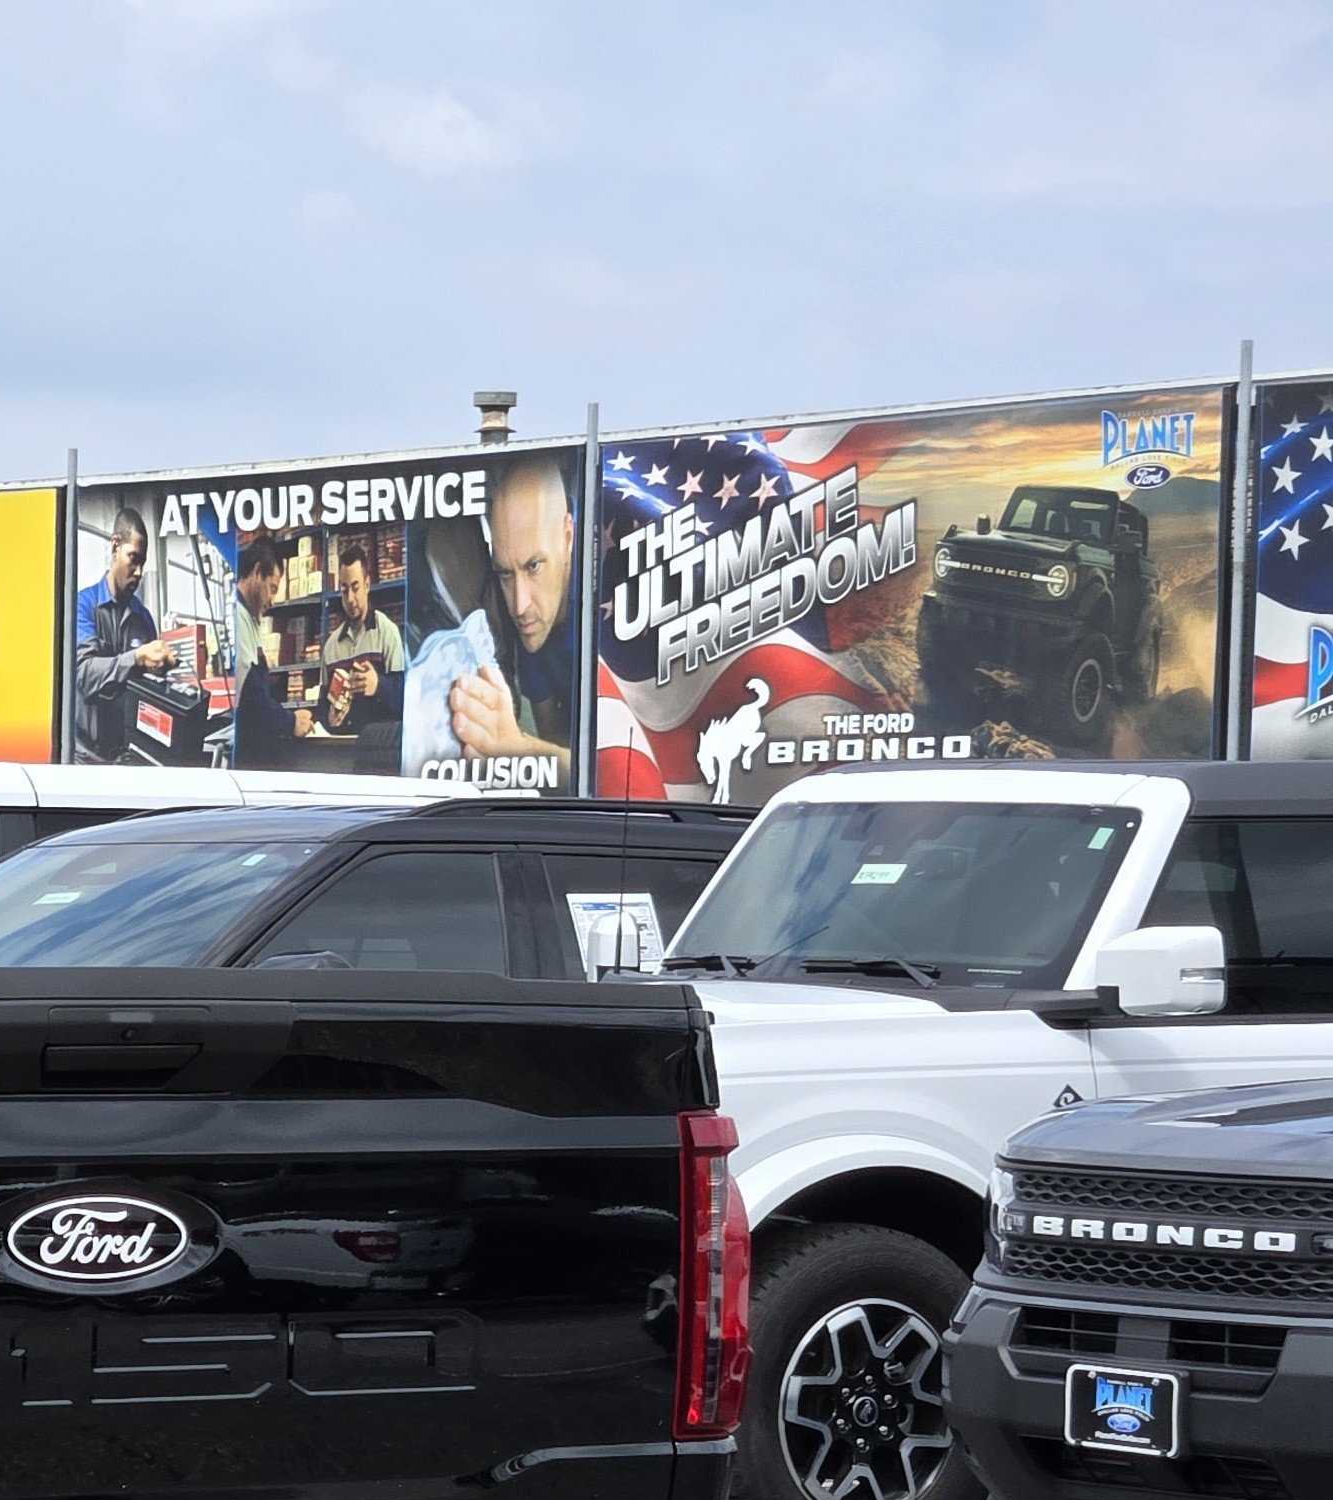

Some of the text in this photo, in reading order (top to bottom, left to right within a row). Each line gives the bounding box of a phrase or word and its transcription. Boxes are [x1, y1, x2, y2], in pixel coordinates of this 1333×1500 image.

[1101, 410, 1197, 466] PLANET
[160, 470, 487, 537] AT YOUR SERVICE
[1134, 467, 1164, 486] Ford
[614, 467, 858, 642] ULTIMATE
[620, 503, 696, 577] THE
[657, 501, 917, 686] FREEDOM!
[767, 735, 972, 764] BRONCO
[823, 713, 914, 736] THE FORD
[40, 1208, 156, 1264] Ford
[1033, 1215, 1296, 1252] BRONCO
[1096, 1376, 1152, 1417] PLANET
